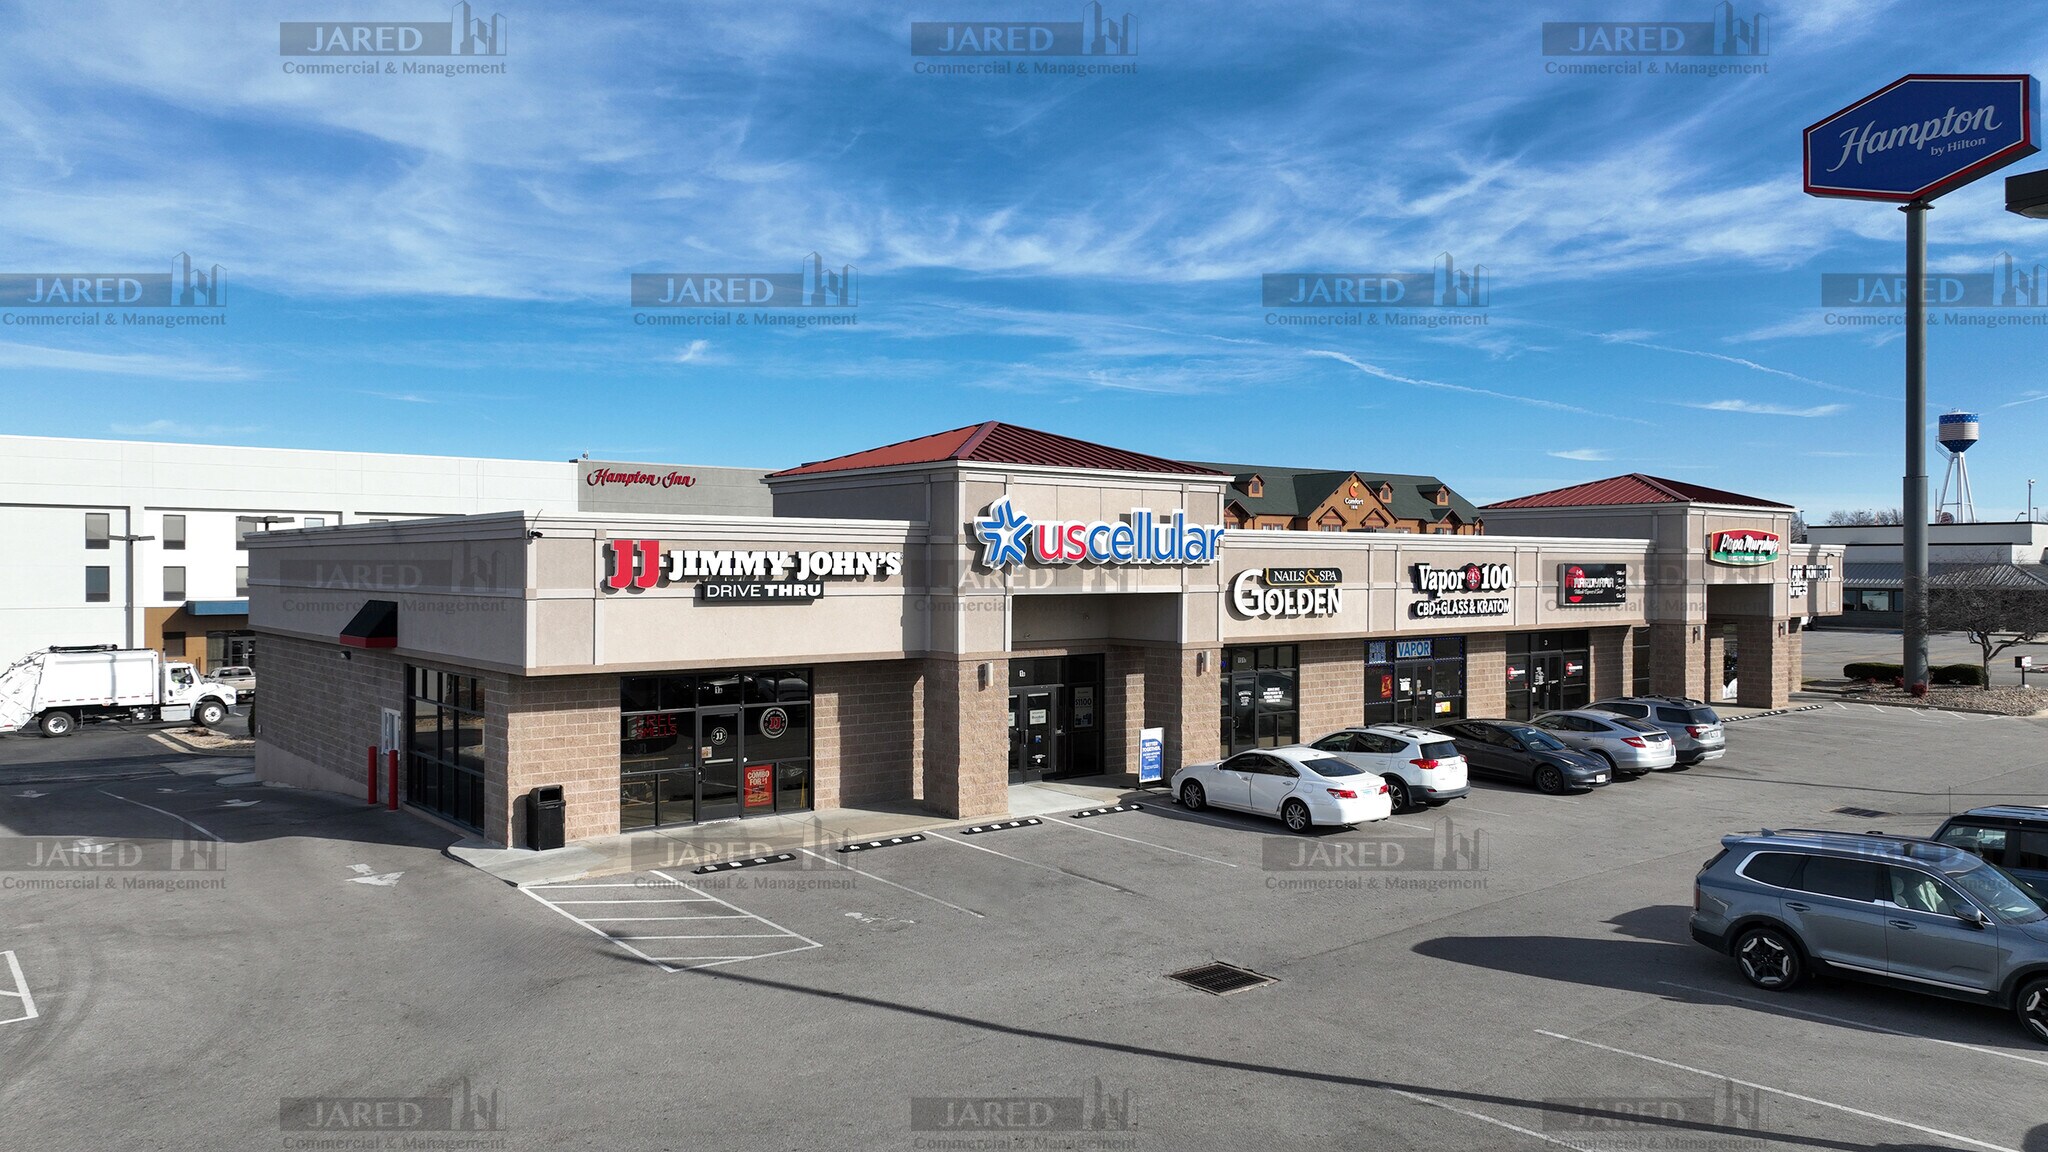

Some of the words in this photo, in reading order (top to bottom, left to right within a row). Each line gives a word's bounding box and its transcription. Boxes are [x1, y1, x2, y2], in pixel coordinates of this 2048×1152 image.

[1826, 105, 2003, 173] Hampton
[1930, 145, 1946, 157] by
[1947, 137, 1986, 152] Hilton
[587, 467, 661, 487] Hampton
[662, 471, 697, 488] Inn
[1719, 533, 1745, 554] Papa
[610, 540, 660, 589] JJ
[668, 550, 789, 581] JIMMY
[797, 551, 902, 581] JOHN'S
[706, 583, 762, 598] DRIVE
[764, 583, 822, 597] THRU
[1418, 564, 1466, 597] Vapor
[1481, 565, 1513, 590] 100
[1233, 568, 1343, 617] GOLDEN
[1476, 599, 1511, 614] KRATOM
[1397, 641, 1430, 656] VAPOR
[636, 714, 677, 727] FREE
[636, 725, 678, 739] SMELLS
[747, 770, 770, 780] COMBO
